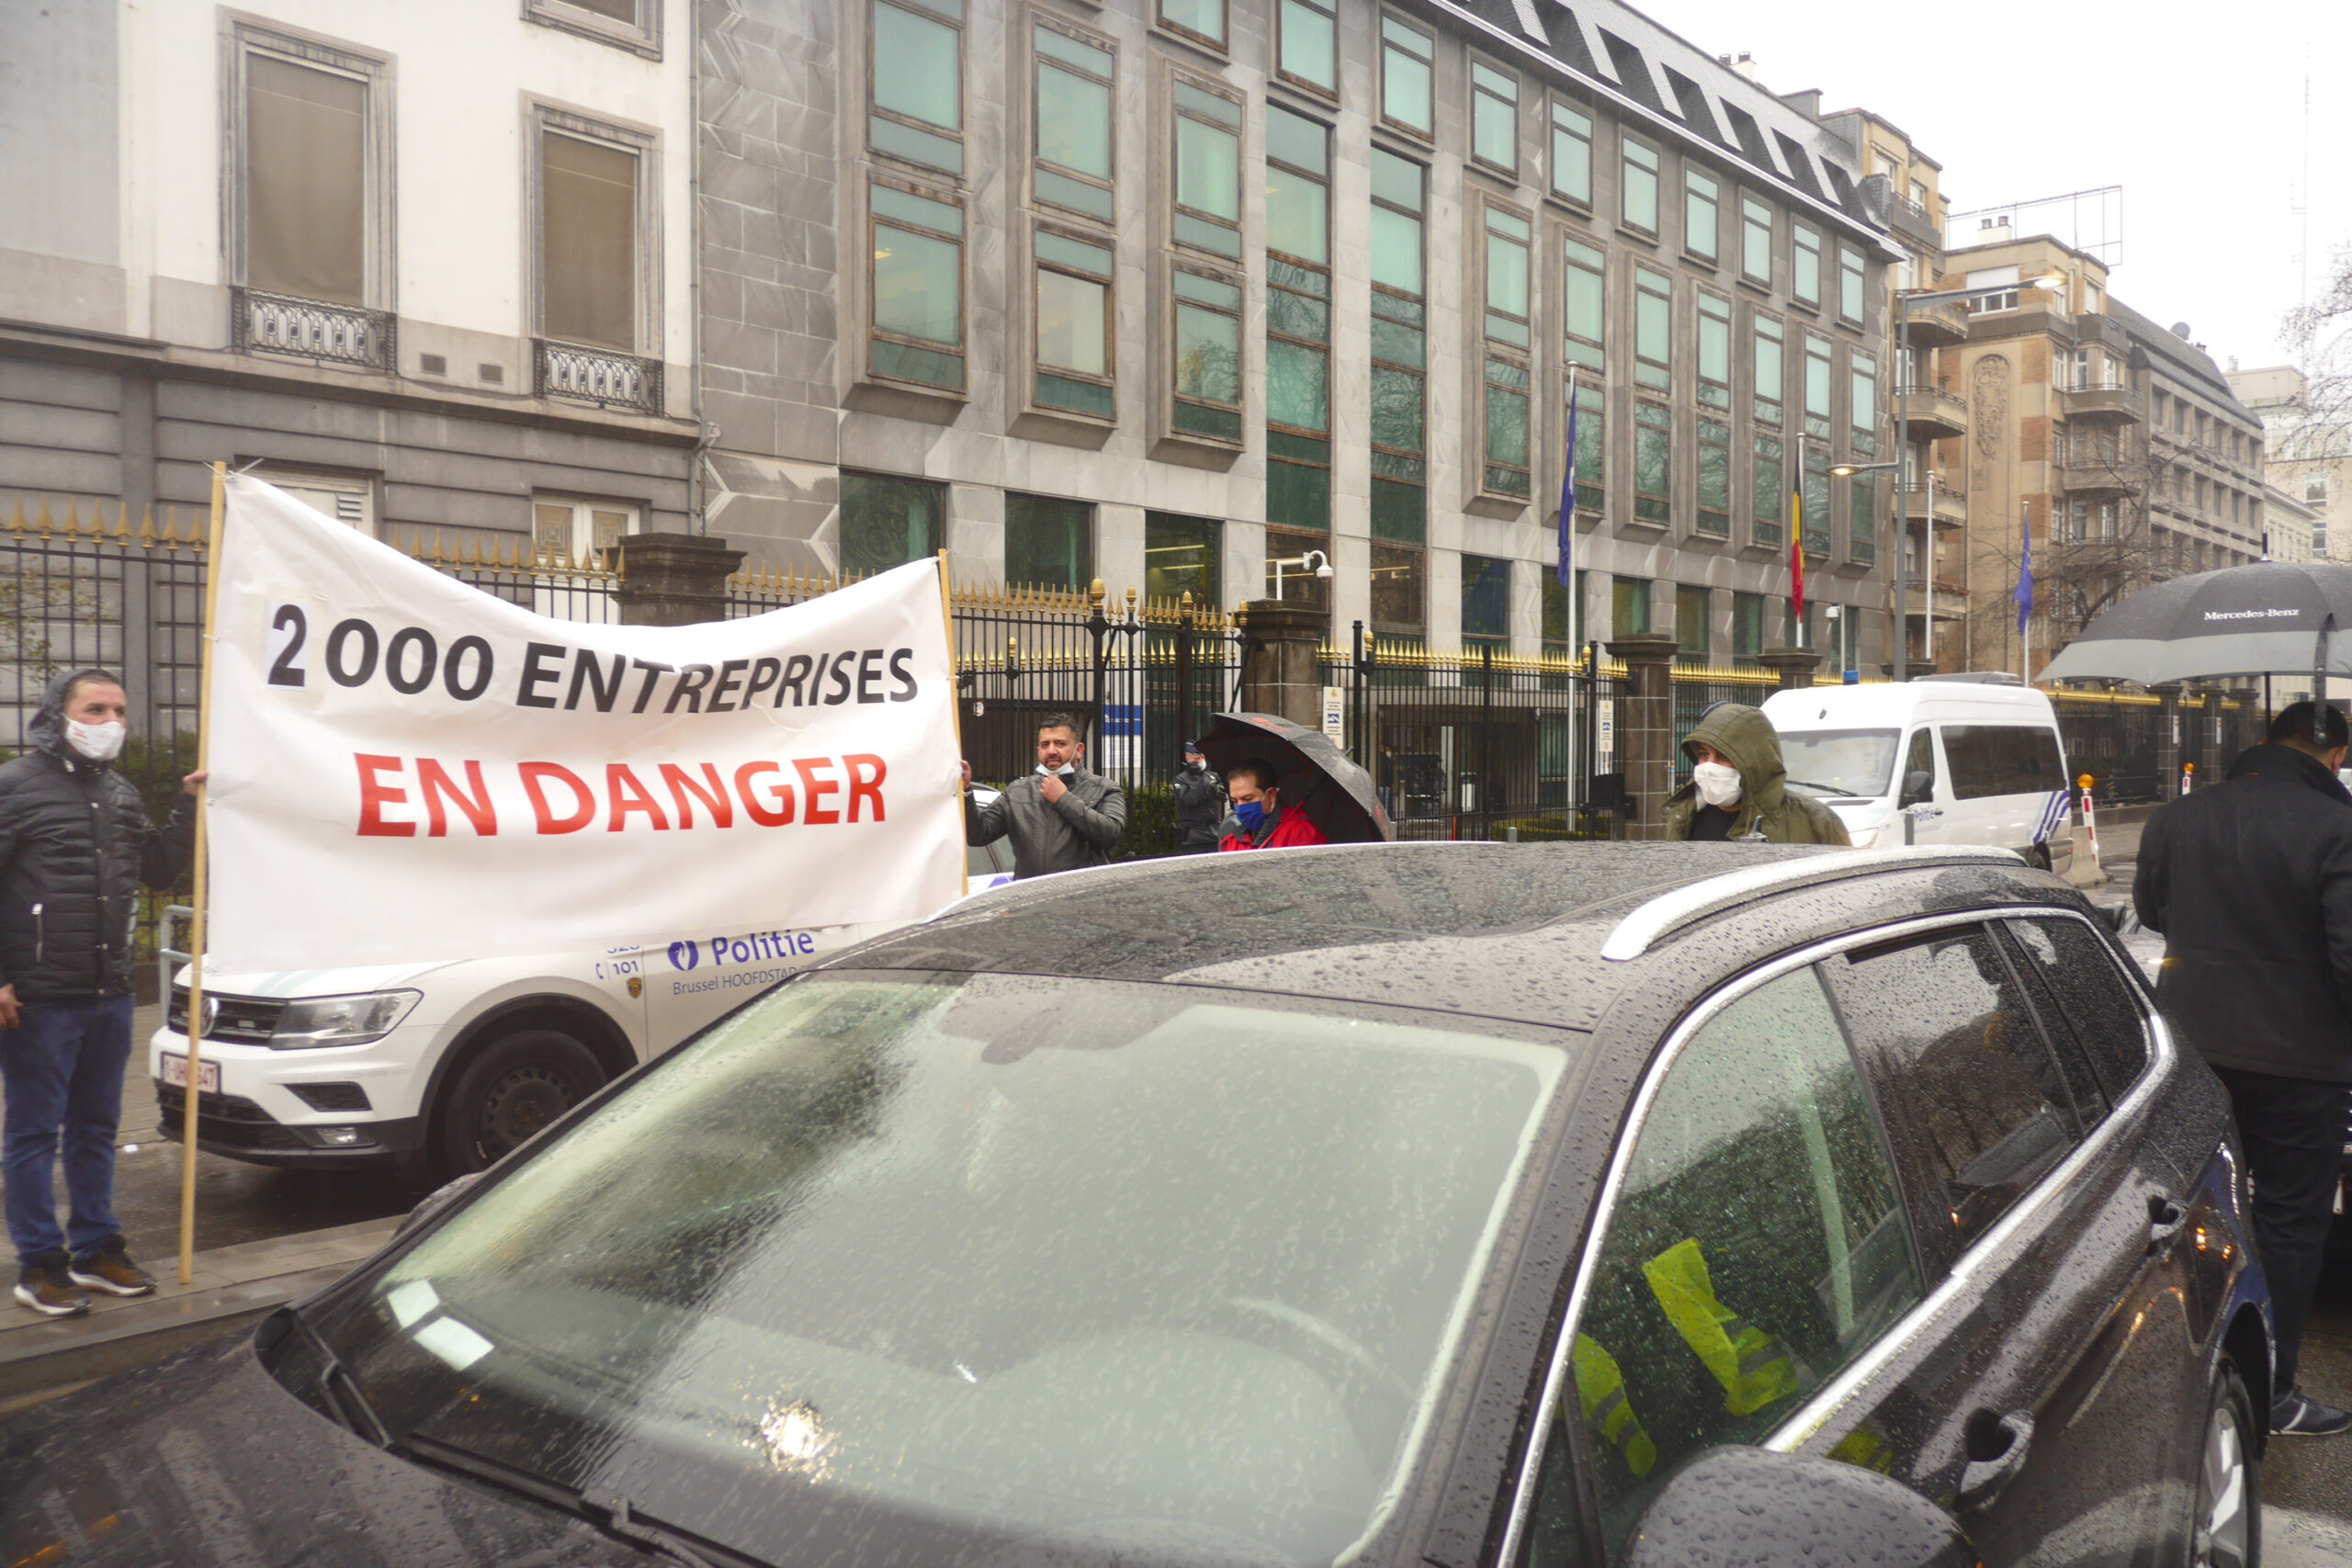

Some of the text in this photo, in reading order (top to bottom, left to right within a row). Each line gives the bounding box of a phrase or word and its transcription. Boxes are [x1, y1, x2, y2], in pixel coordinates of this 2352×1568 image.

[2204, 608, 2301, 621] Mercedes-Benz
[515, 641, 919, 715] ENTREPRISES
[353, 752, 888, 838] EN DANGER
[712, 930, 815, 964] Politie
[614, 961, 639, 975] 101
[673, 976, 718, 995] Brussel
